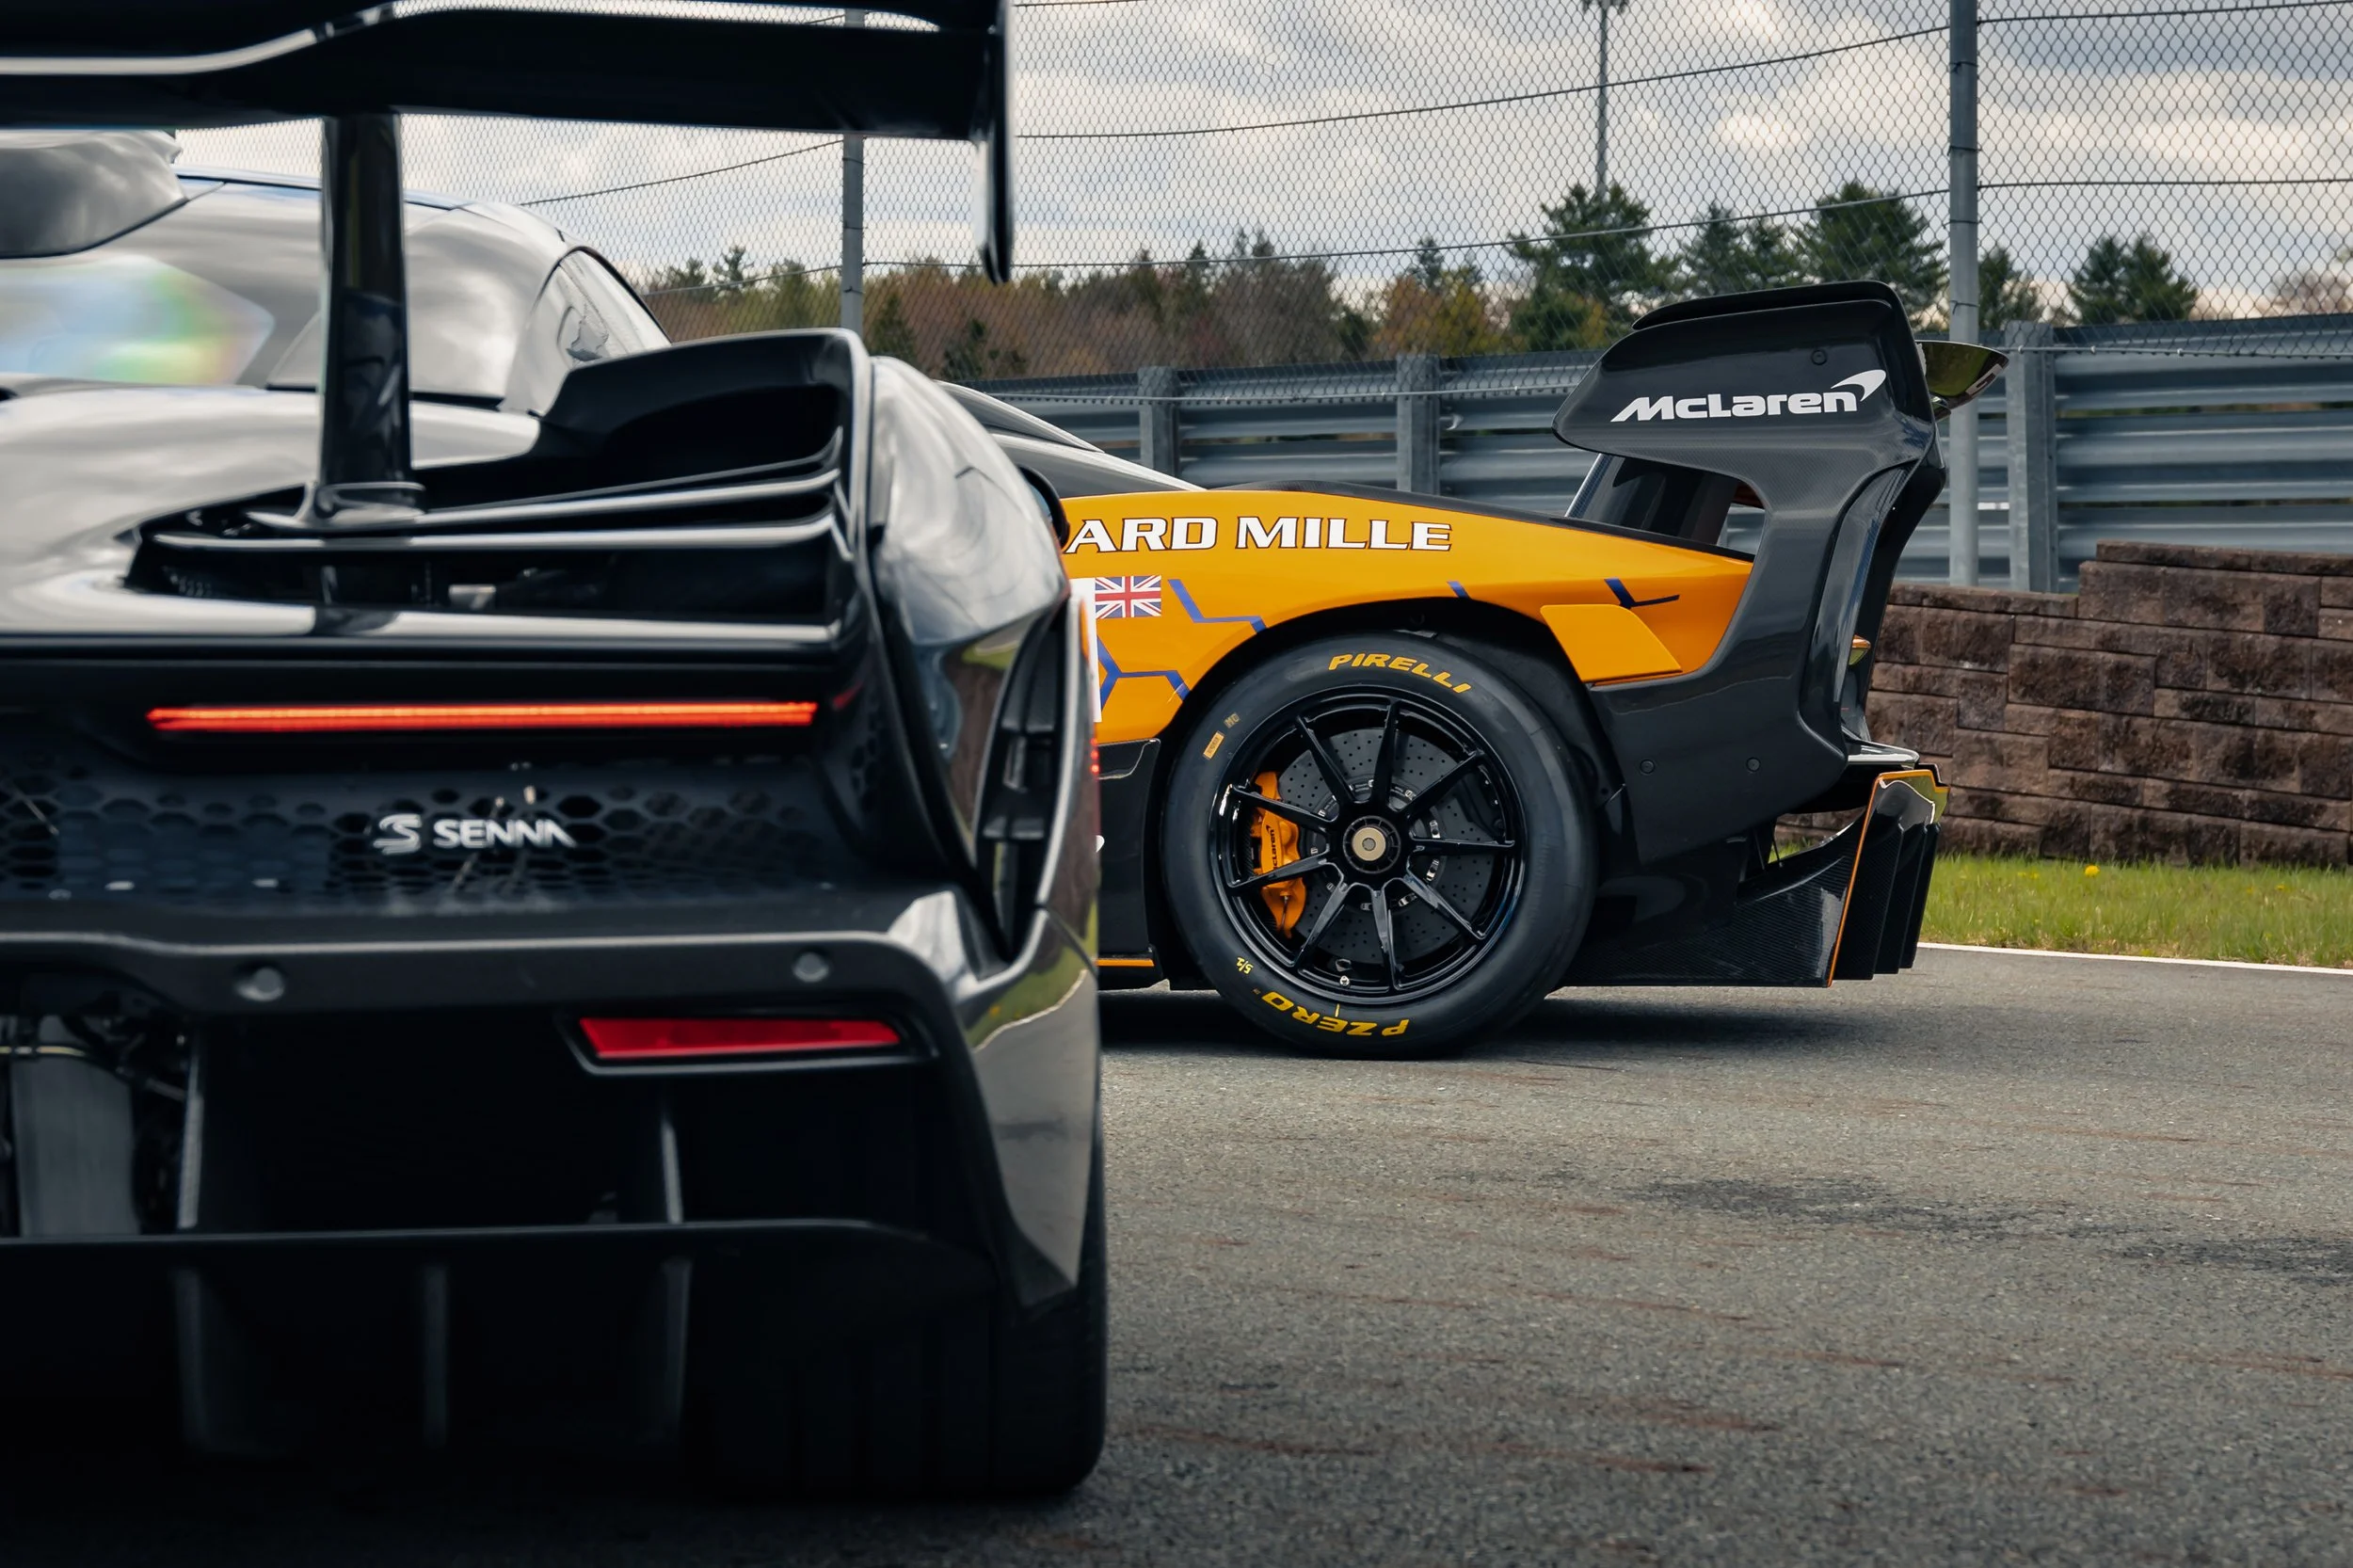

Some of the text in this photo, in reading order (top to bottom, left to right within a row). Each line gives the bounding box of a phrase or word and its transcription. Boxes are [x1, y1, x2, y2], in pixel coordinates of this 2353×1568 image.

[1610, 392, 1858, 422] McLaren
[1235, 516, 1453, 552] MILLE
[1328, 653, 1472, 694] PIRELLI
[433, 819, 577, 848] SENNA
[1270, 829, 1278, 870] cLaren
